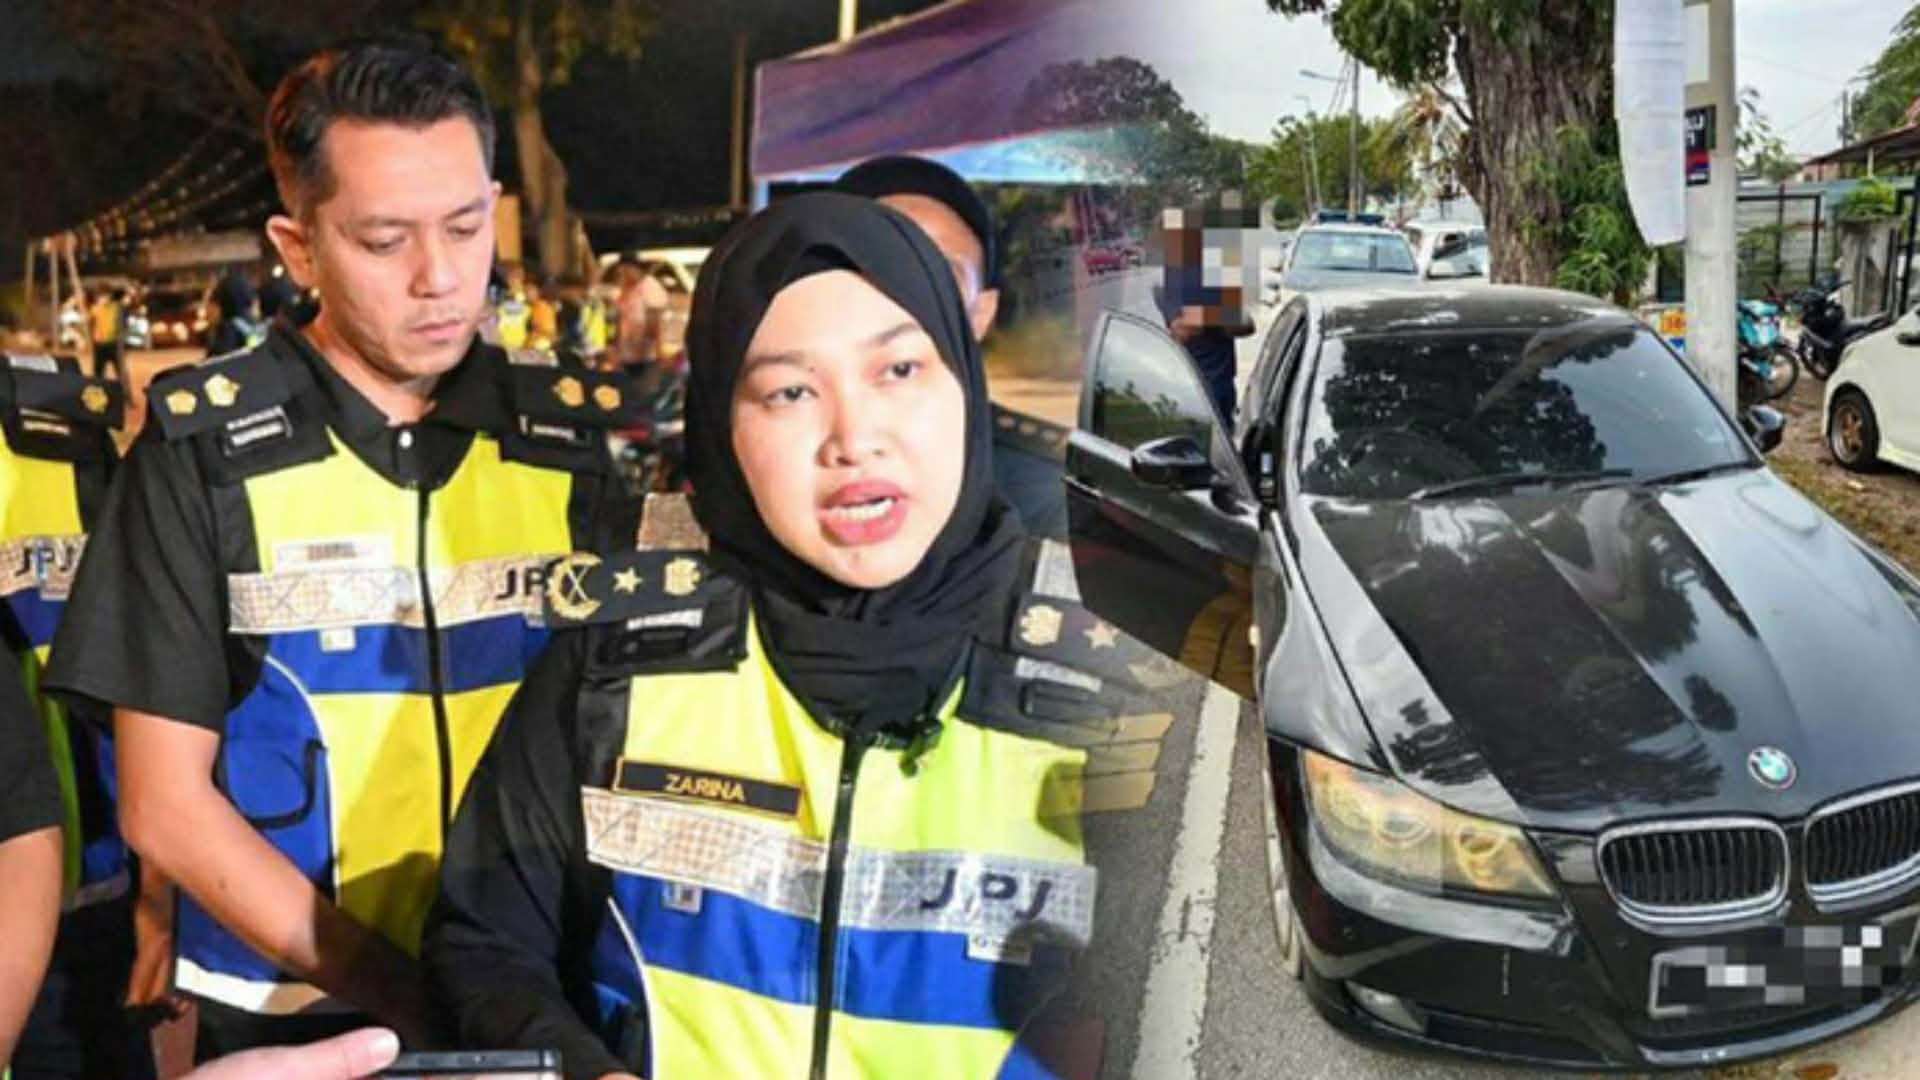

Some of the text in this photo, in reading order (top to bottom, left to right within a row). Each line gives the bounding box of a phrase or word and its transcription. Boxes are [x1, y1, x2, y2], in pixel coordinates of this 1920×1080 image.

[14, 545, 75, 577] JPJ
[495, 566, 547, 600] JP
[664, 772, 747, 802] ZARINA
[920, 868, 1051, 920] JPJ
